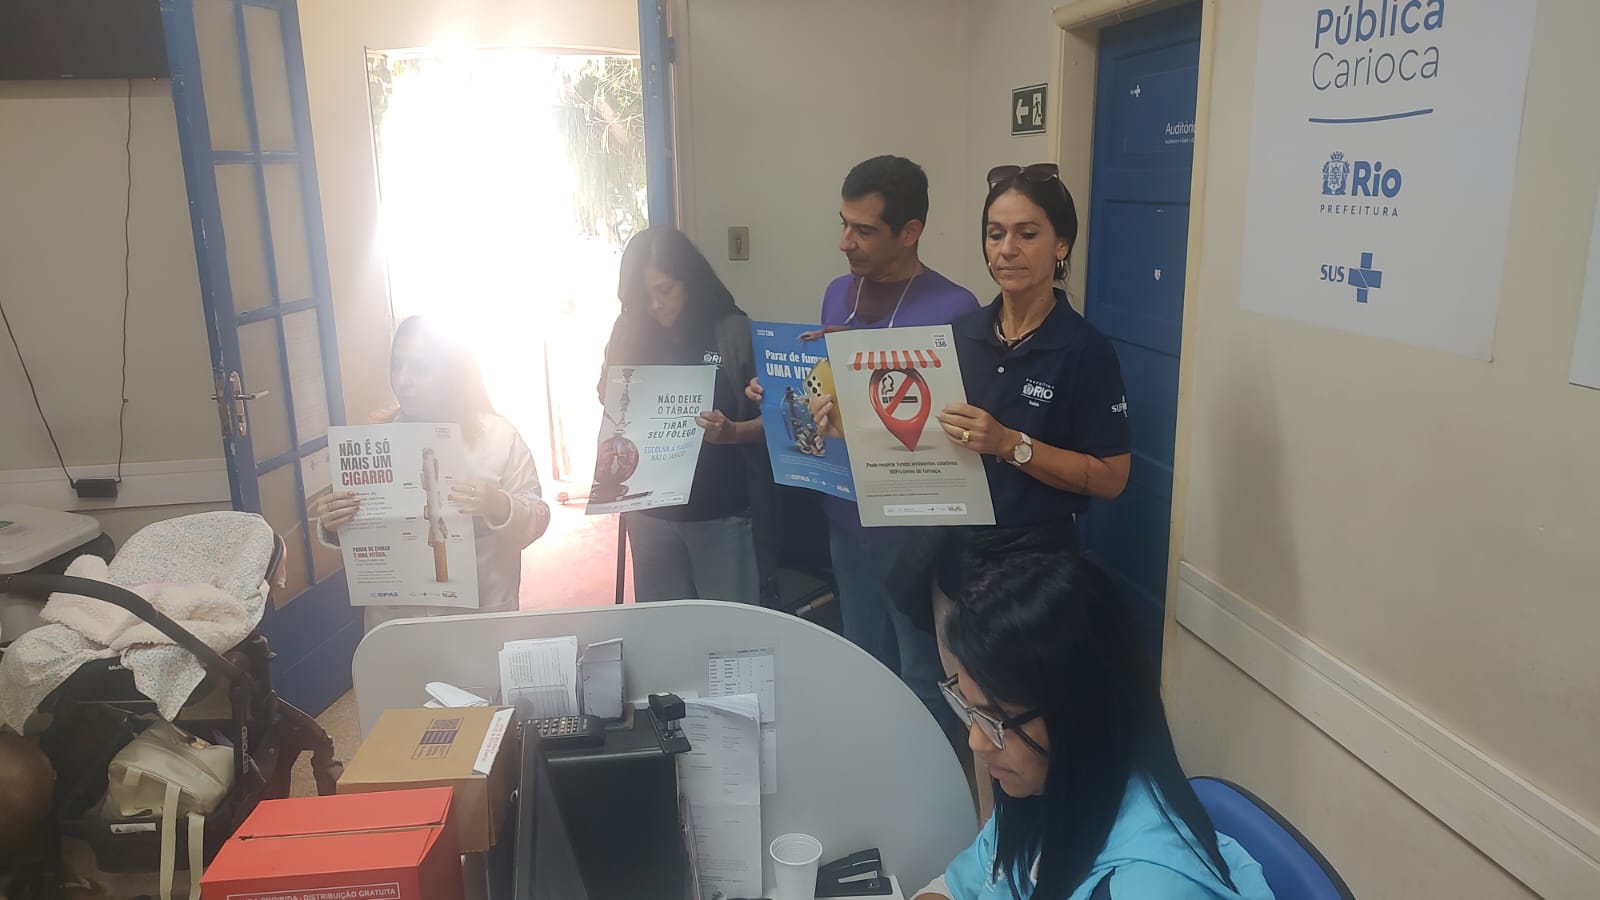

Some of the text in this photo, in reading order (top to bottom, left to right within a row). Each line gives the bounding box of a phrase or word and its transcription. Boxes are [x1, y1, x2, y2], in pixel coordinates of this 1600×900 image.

[1315, 0, 1445, 49] Pública
[1312, 46, 1440, 90] Carioca
[1165, 119, 1195, 135] Auditóri
[1351, 160, 1402, 198] Rio
[1320, 204, 1399, 217] PREFEITURA
[1320, 264, 1345, 283] SUS
[765, 350, 787, 361] Parar
[789, 352, 800, 362] de
[766, 362, 812, 380] UMA VIT
[678, 394, 703, 404] DEIXE
[657, 406, 700, 415] O TABACO
[663, 420, 688, 430] TIRAR
[647, 431, 664, 439] SEU
[339, 438, 390, 456] NÃO É SÓ
[340, 455, 392, 470] MAIS UM
[342, 469, 393, 486] CIGARRO
[303, 890, 357, 900] DISTRIBUIÇÃO
[359, 888, 396, 897] GRATUITA
